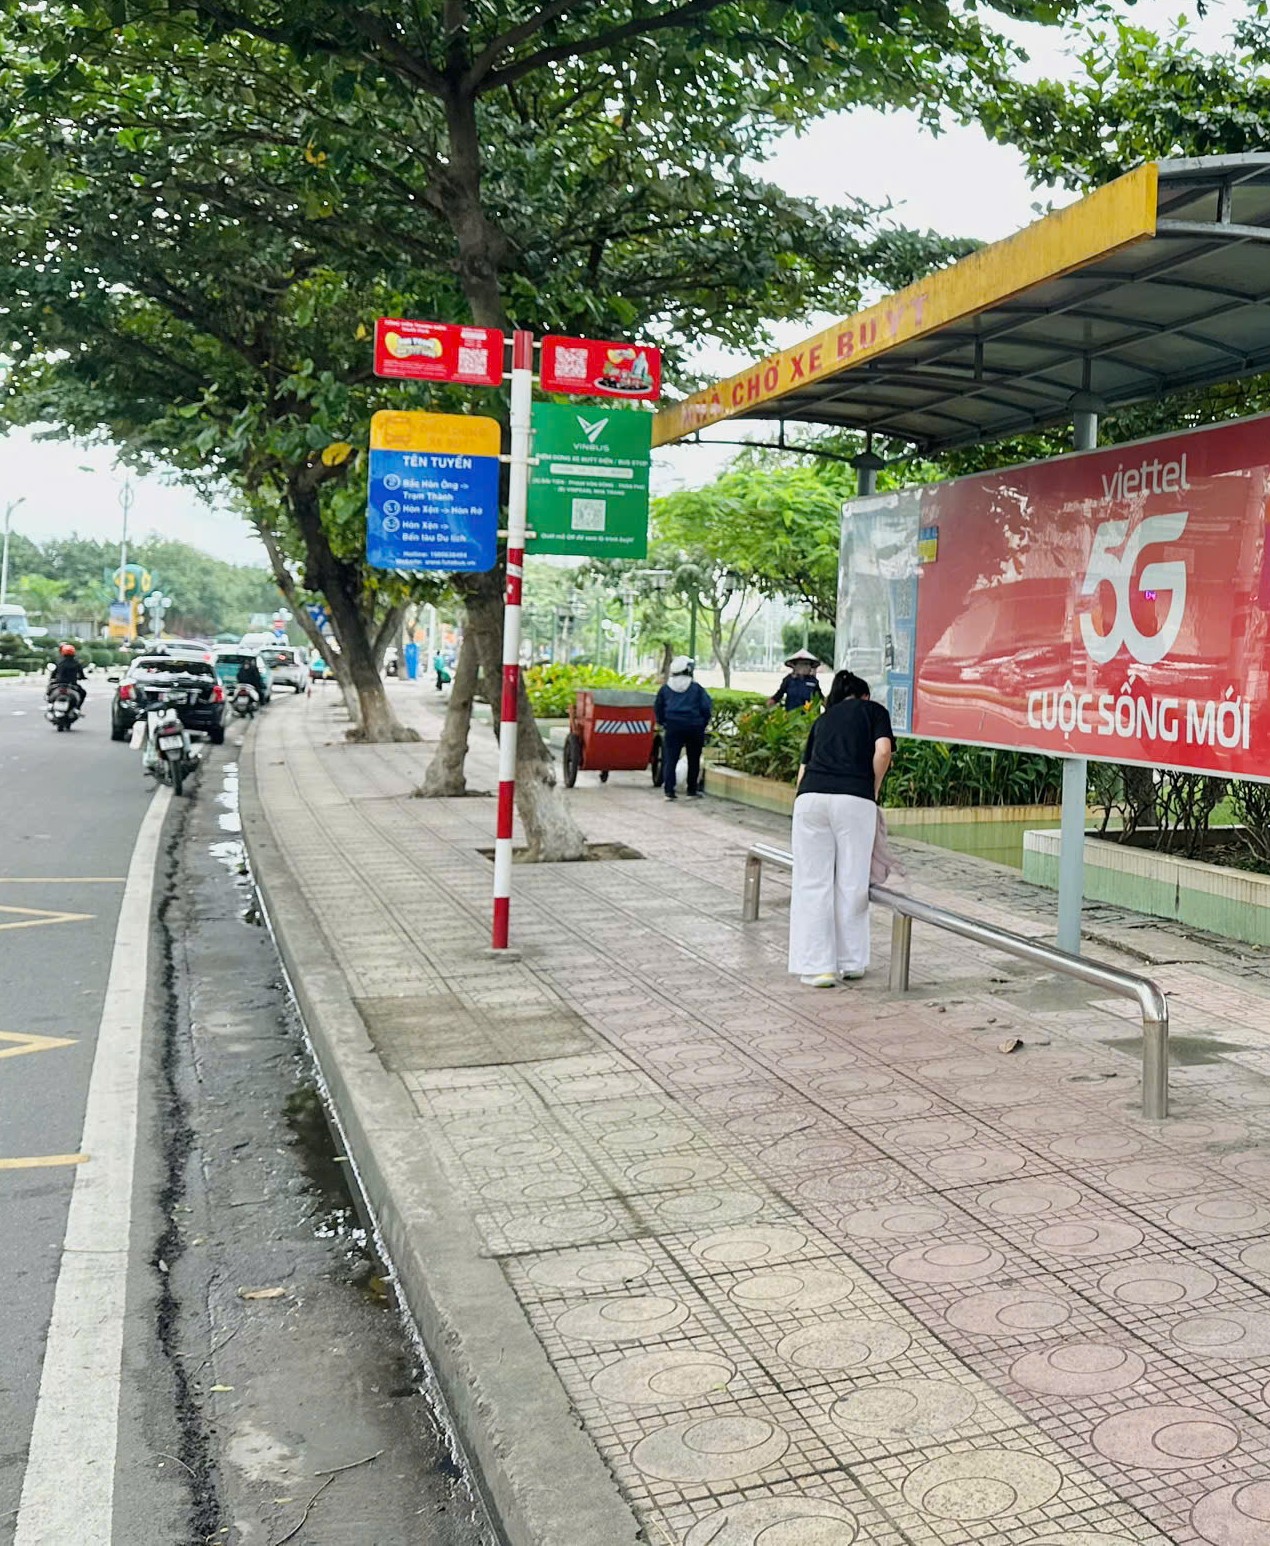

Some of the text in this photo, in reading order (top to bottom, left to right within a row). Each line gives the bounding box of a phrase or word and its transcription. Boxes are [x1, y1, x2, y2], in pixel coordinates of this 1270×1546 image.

[731, 358, 780, 407] CHỜ
[790, 343, 823, 383] XE
[403, 454, 472, 469] TÊN TUYẾN
[573, 443, 610, 452] VINBUS
[1101, 453, 1191, 502] viettel
[1079, 511, 1190, 665] 5G
[1027, 673, 1251, 750] CUỘC SỐNG MỚI
